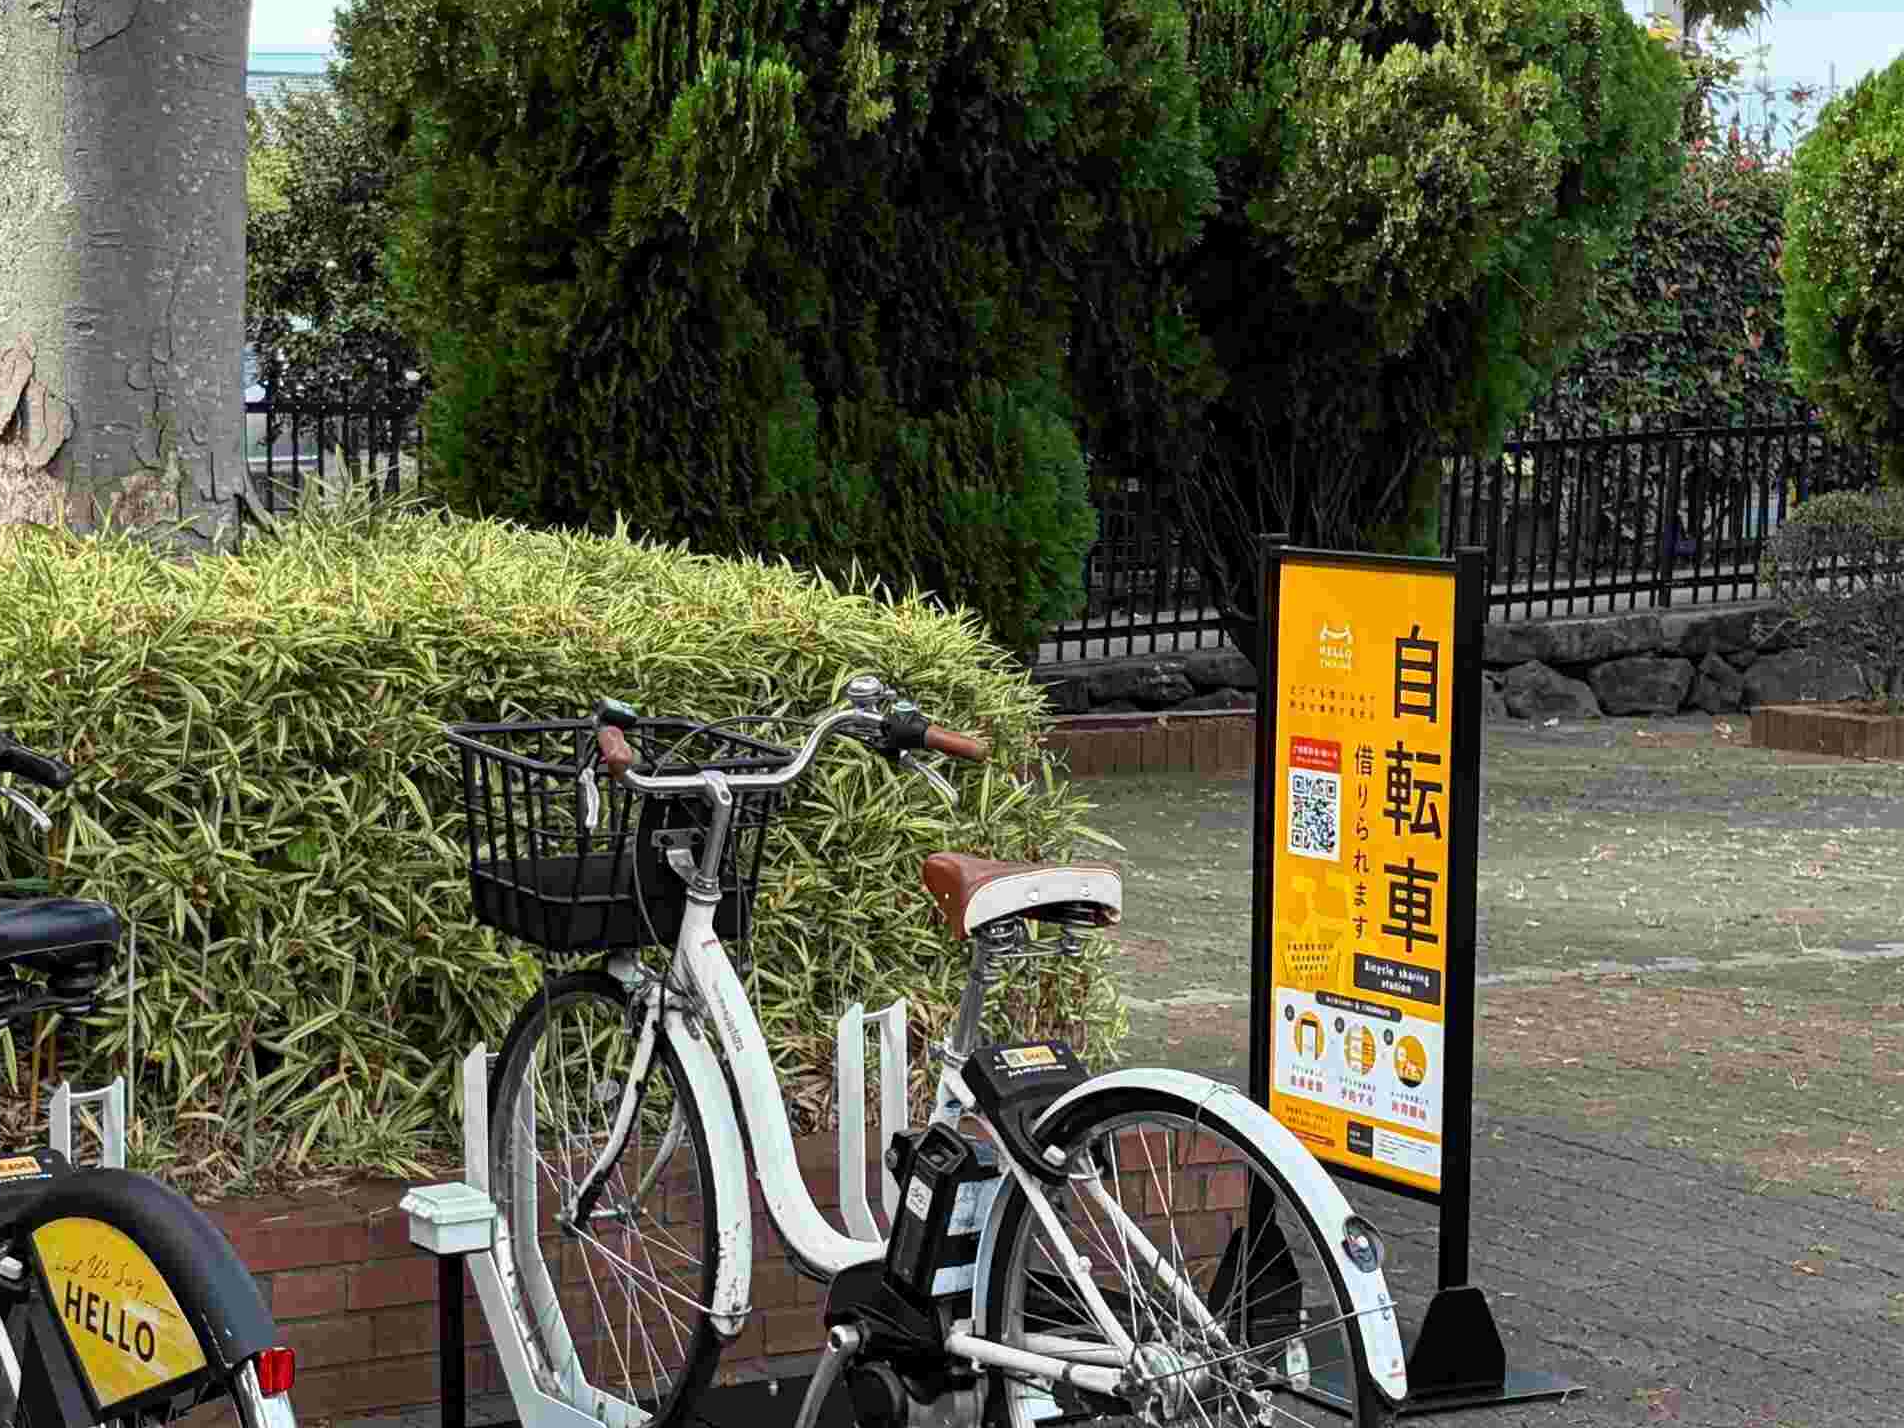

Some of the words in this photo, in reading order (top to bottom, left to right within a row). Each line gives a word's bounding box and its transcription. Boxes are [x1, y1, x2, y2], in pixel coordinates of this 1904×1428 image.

[1352, 744, 1374, 939] 借りられます
[1382, 624, 1443, 953] 自転車
[64, 1279, 155, 1363] HELLO
